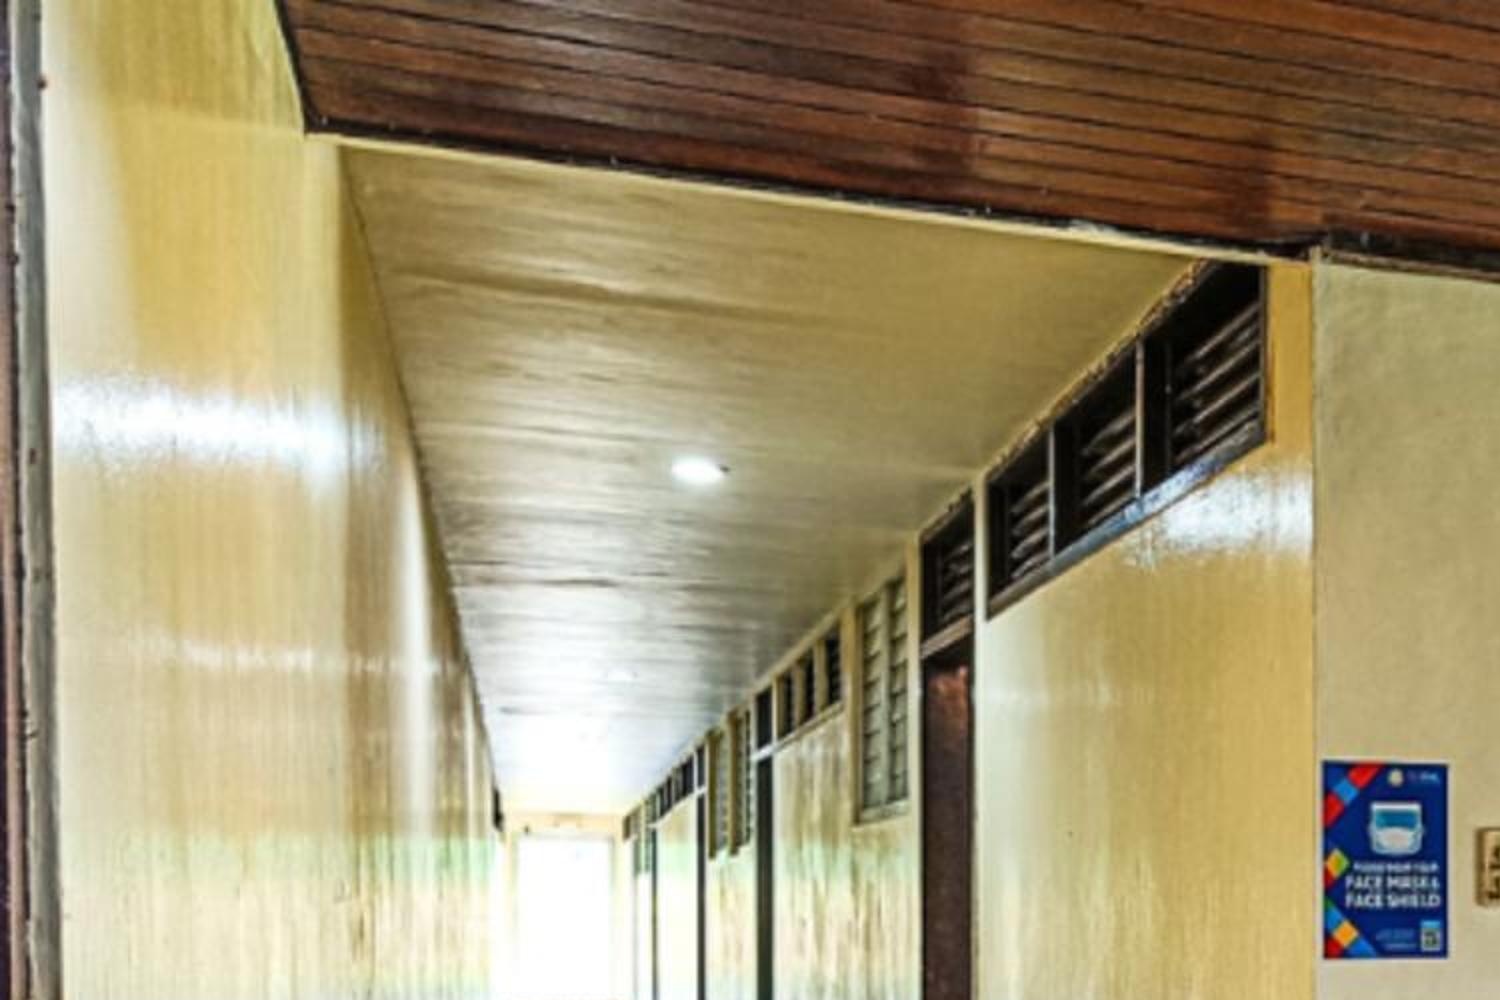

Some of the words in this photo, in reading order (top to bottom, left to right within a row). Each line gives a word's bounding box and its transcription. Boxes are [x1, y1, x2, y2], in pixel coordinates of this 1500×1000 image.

[1345, 874, 1383, 889] FACE
[1345, 893, 1383, 909] FACE
[1386, 893, 1442, 909] SHIELD
